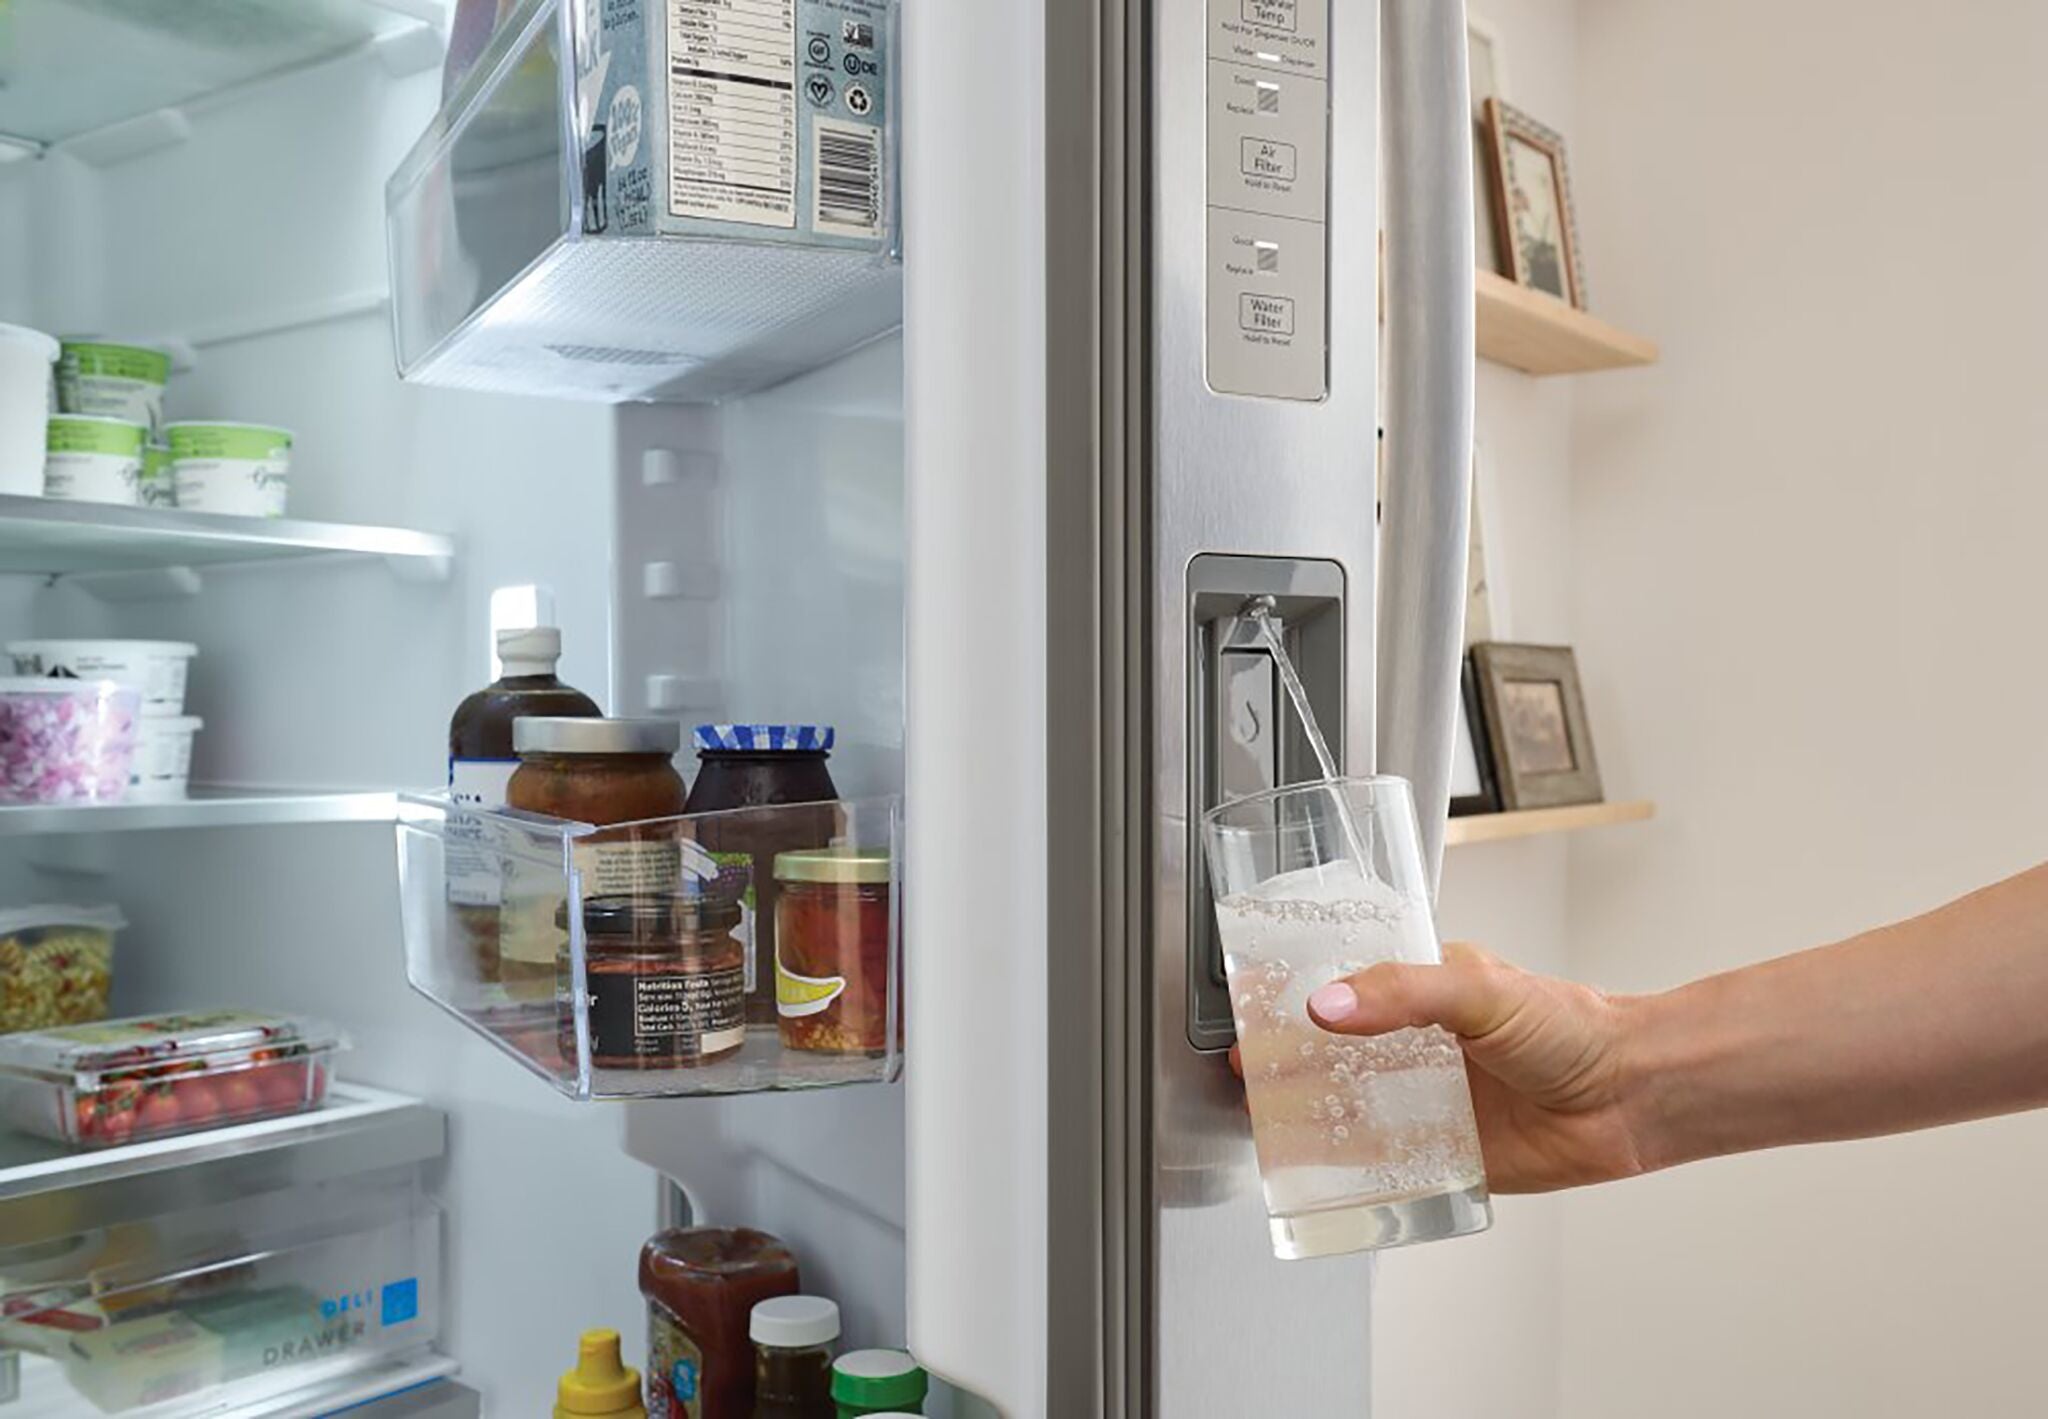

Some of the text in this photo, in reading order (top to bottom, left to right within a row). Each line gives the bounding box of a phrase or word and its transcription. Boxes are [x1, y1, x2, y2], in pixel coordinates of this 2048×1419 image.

[1254, 5, 1285, 24] Temp
[1260, 143, 1277, 157] Air
[1253, 157, 1283, 173] Filter
[1249, 298, 1284, 314] Water
[1253, 312, 1282, 328] Filter
[637, 980, 683, 991] Nutrition
[637, 1002, 680, 1014] Calories
[318, 1288, 373, 1321] DELI
[262, 1319, 366, 1367] DRAWER
